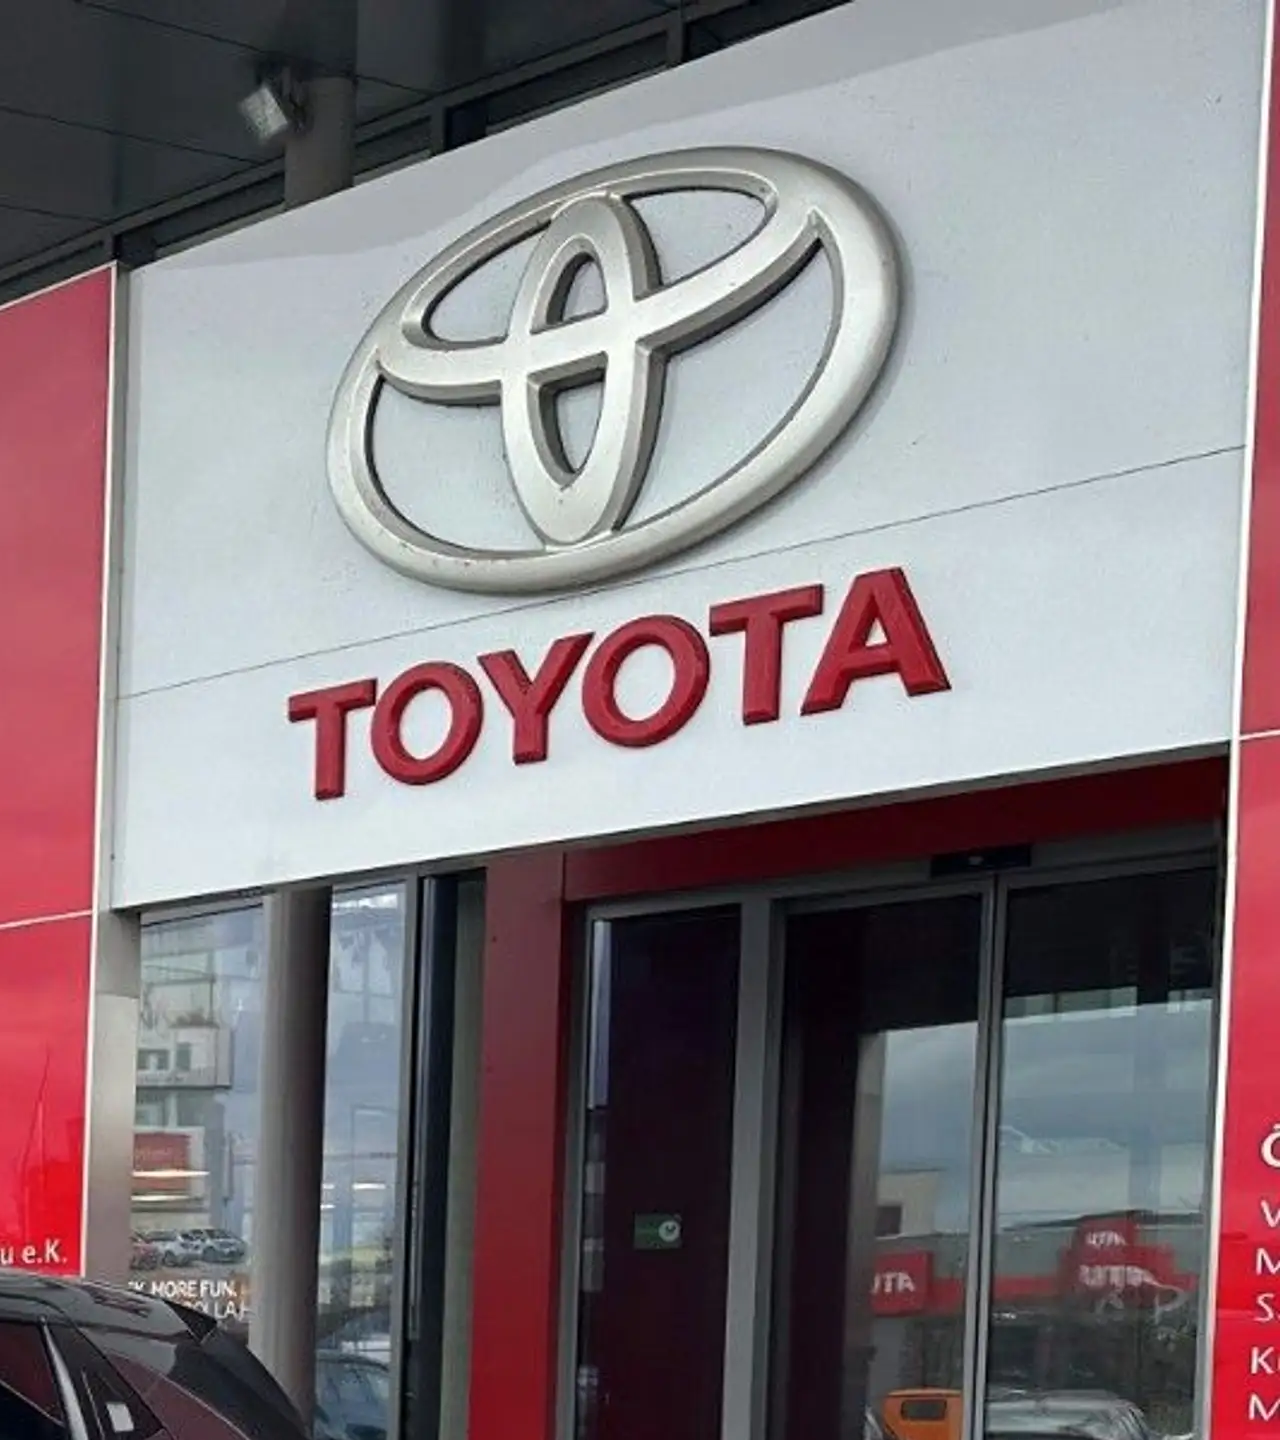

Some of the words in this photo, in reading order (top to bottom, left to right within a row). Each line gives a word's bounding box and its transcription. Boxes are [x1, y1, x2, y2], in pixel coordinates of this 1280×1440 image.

[289, 566, 951, 800] TOYOTA
[21, 1238, 68, 1264] e.K.
[150, 1279, 197, 1298] MORE
